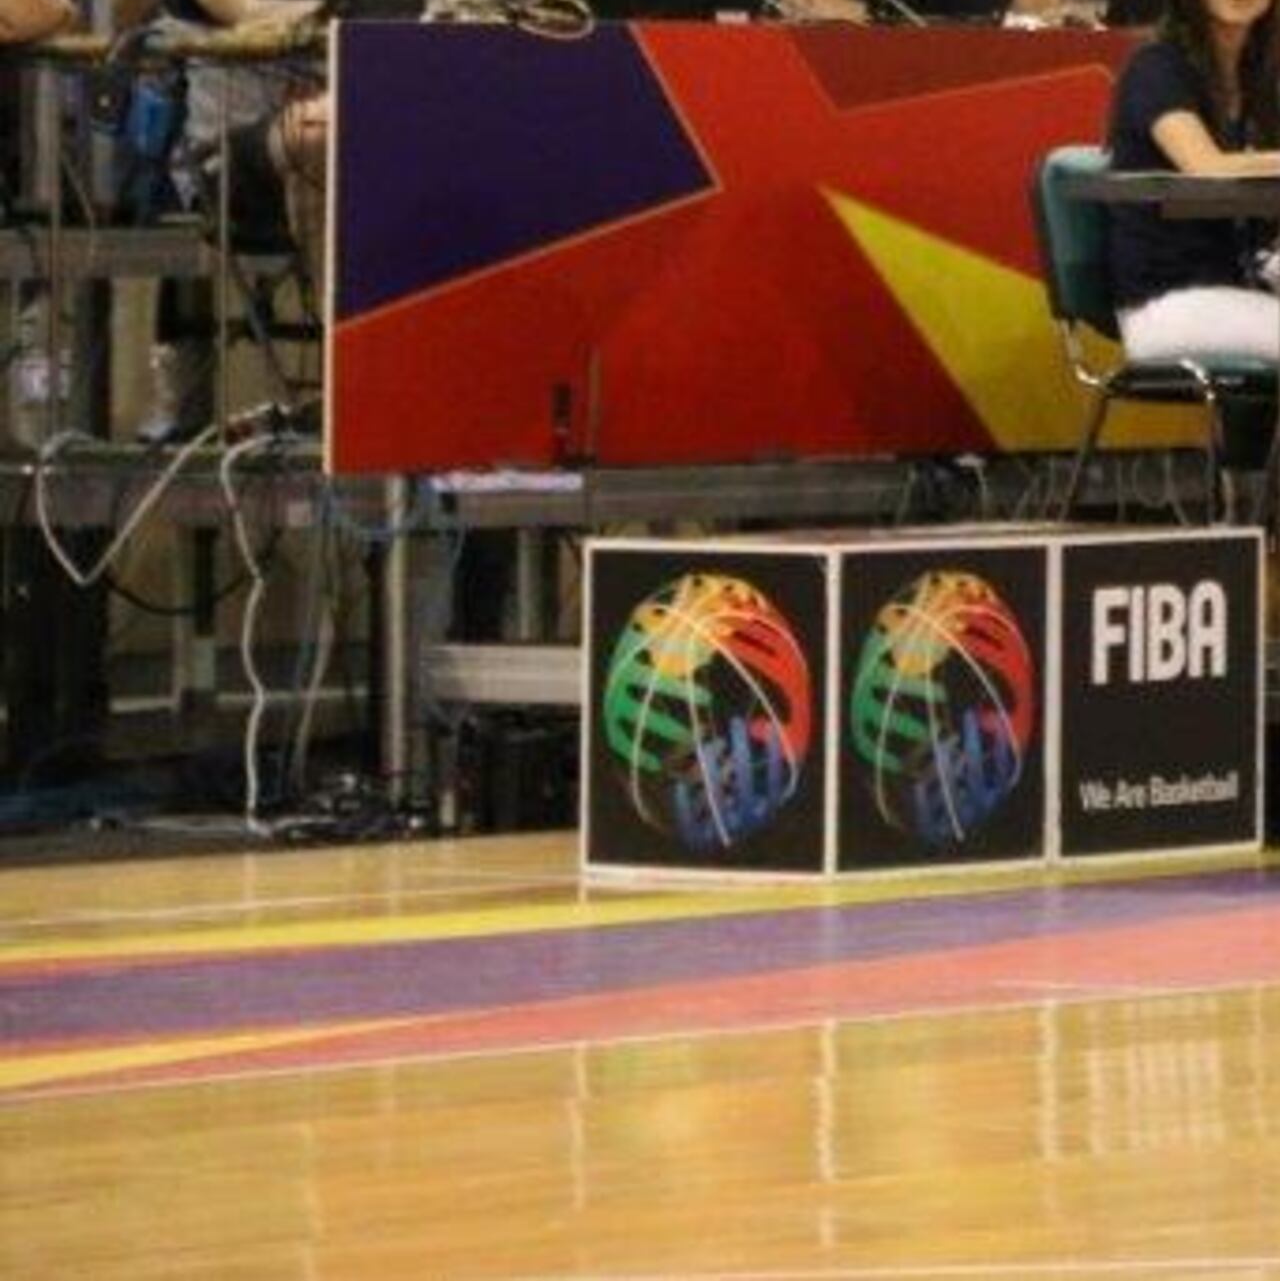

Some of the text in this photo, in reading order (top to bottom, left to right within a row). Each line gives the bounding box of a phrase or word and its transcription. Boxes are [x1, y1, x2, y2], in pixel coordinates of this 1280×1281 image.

[1093, 579, 1228, 686] FIBA
[1079, 771, 1239, 811] We Are Basketball
